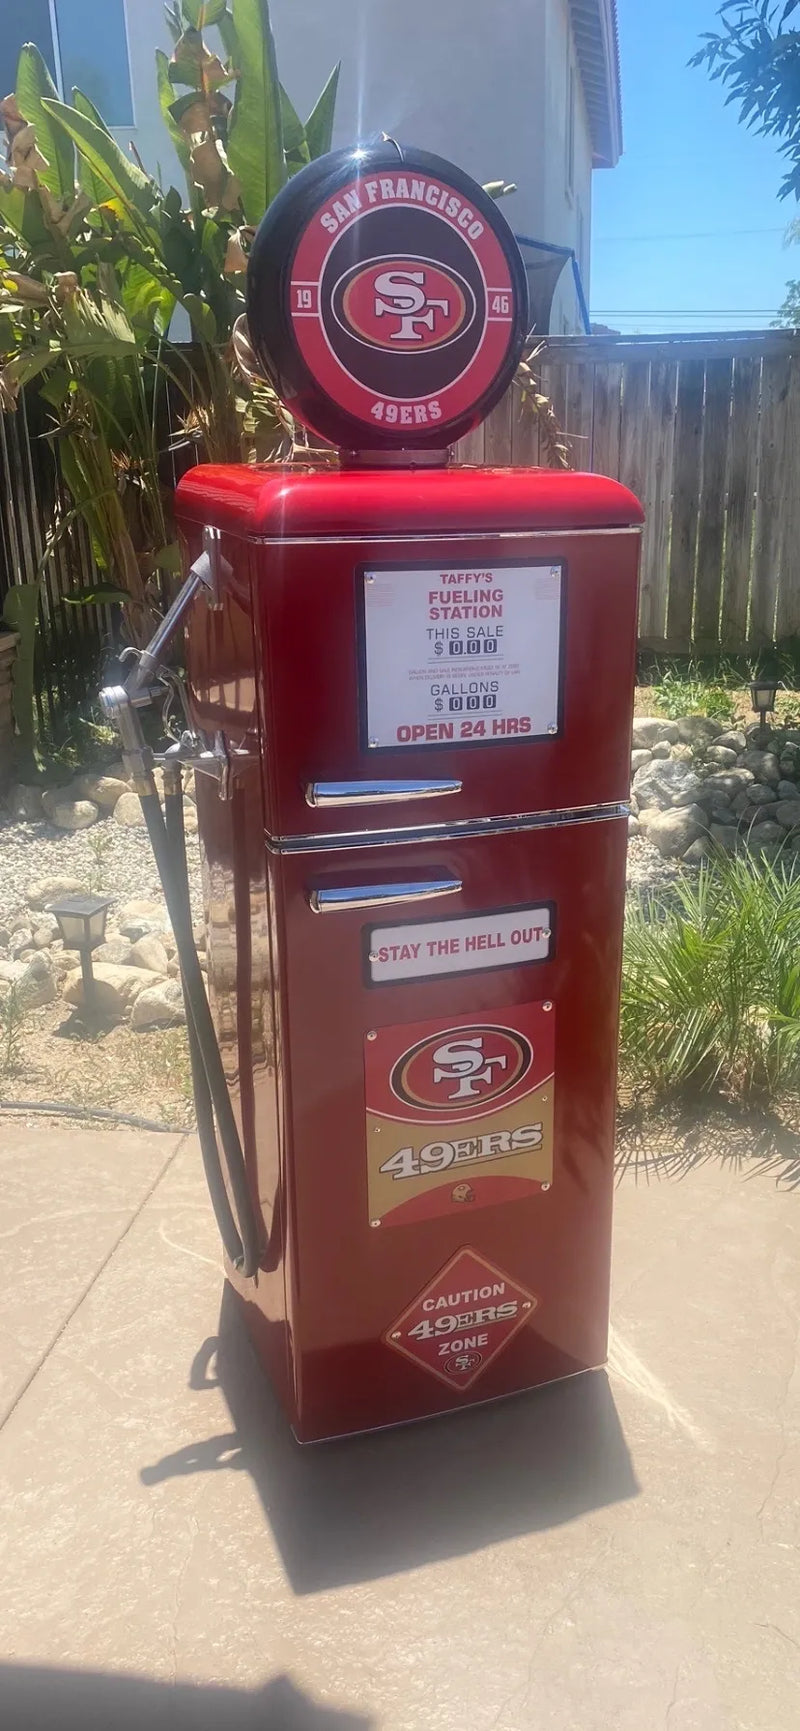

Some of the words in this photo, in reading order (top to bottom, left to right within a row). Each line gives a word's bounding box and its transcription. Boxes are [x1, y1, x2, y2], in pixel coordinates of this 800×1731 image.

[320, 189, 363, 235] SAN
[364, 178, 485, 240] FRANCISCO
[296, 289, 312, 309] 19
[374, 270, 449, 340] SF
[491, 295, 510, 315] 46
[371, 400, 442, 425] 49ERS
[440, 572, 493, 585] TAFFY'S
[428, 589, 504, 605] FUELING
[429, 605, 503, 621] STATION
[426, 627, 460, 640] THIS
[466, 625, 504, 639] SALE
[430, 681, 500, 696] GALLONS
[396, 722, 454, 743] OPEN
[460, 720, 486, 738] 24
[492, 716, 532, 736] HRS
[378, 943, 422, 963] STAY
[426, 938, 460, 957] THE
[465, 932, 506, 952] HELL
[510, 927, 543, 945] OUT
[432, 1037, 507, 1099] SF
[379, 1122, 543, 1180] 49ERS
[422, 1282, 505, 1312] CAUTION
[407, 1300, 519, 1341] 49ERS
[438, 1333, 489, 1356] ZONE
